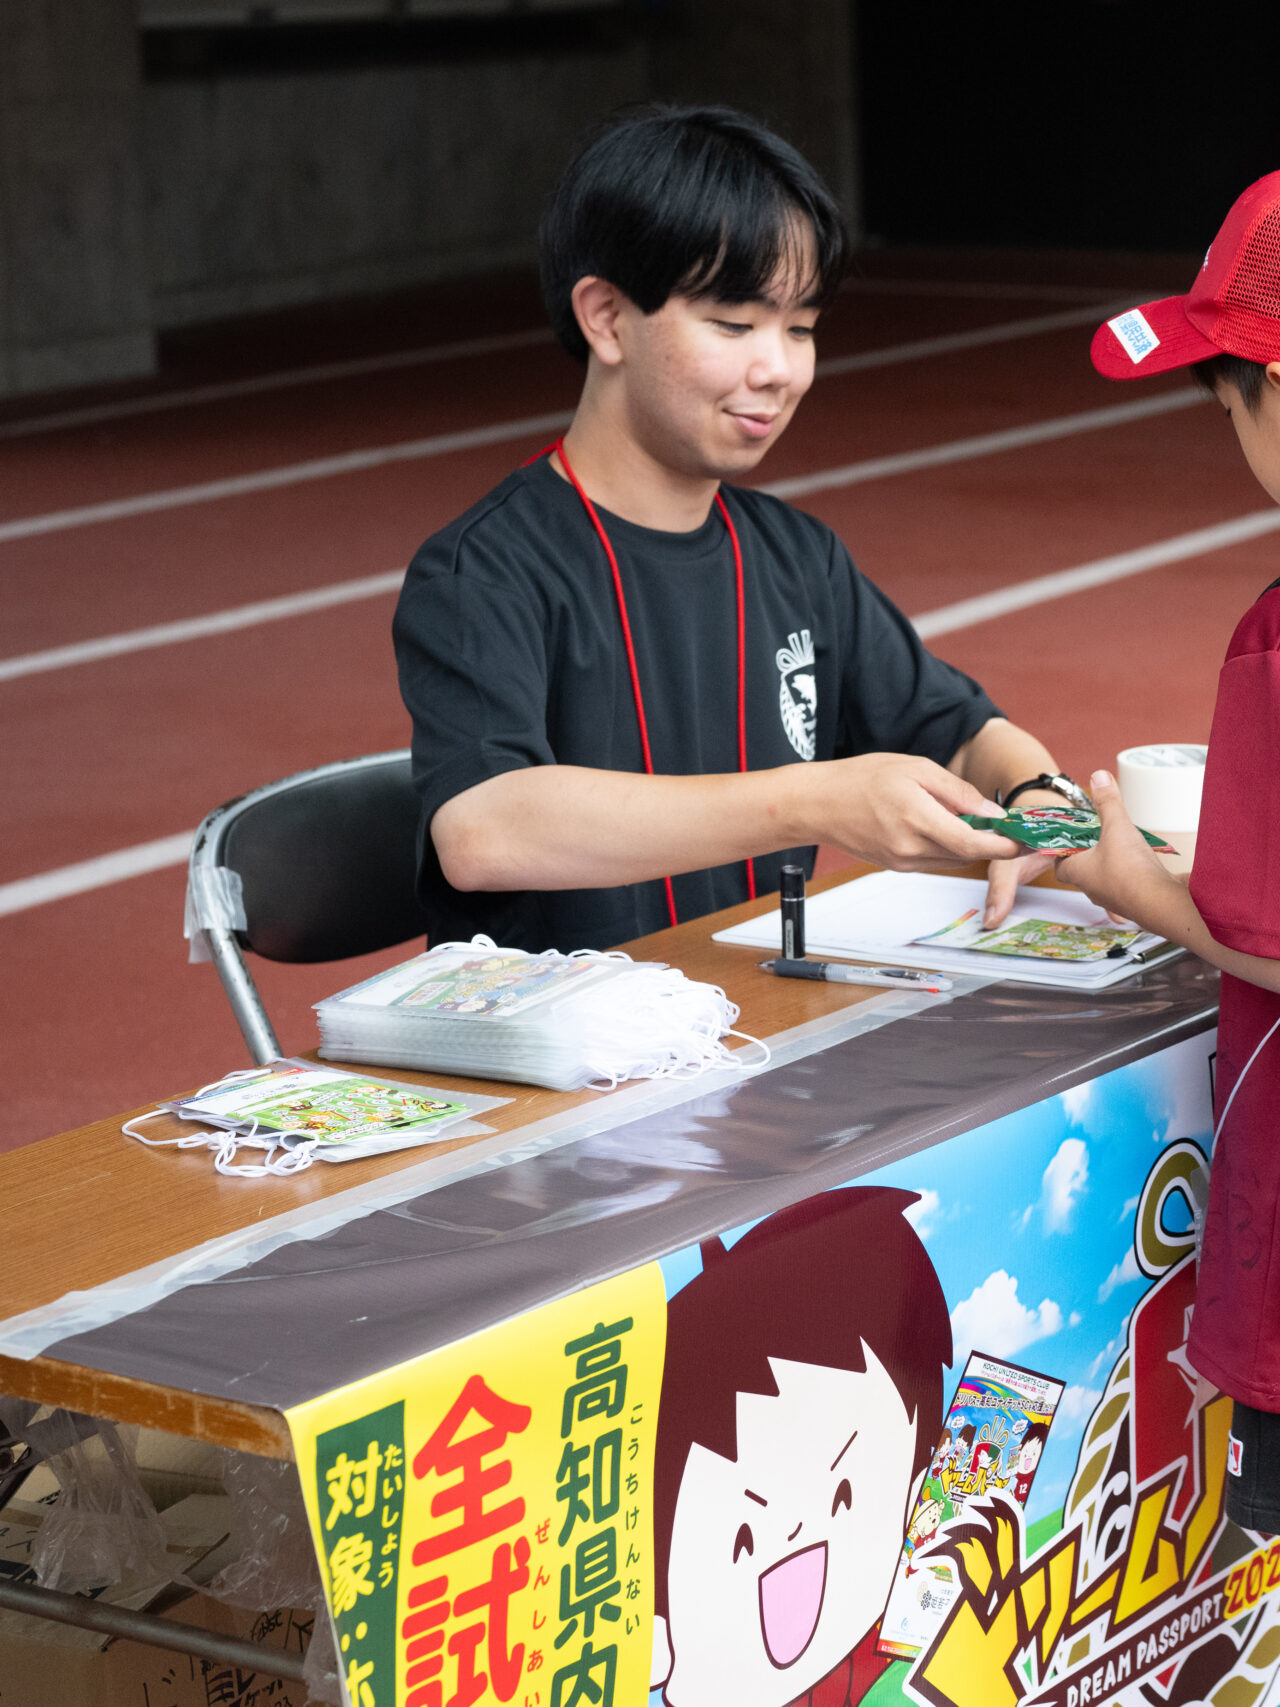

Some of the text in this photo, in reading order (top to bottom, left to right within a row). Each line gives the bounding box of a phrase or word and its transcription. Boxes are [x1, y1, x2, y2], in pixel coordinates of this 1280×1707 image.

[983, 1362, 999, 1373] KOCHI
[378, 1444, 404, 1588] たいしょう
[549, 1316, 634, 1707] 高知県内
[624, 1403, 643, 1636] こうちけんない
[1067, 1649, 1131, 1707] DREAM
[1136, 1593, 1223, 1670] PASSPORT
